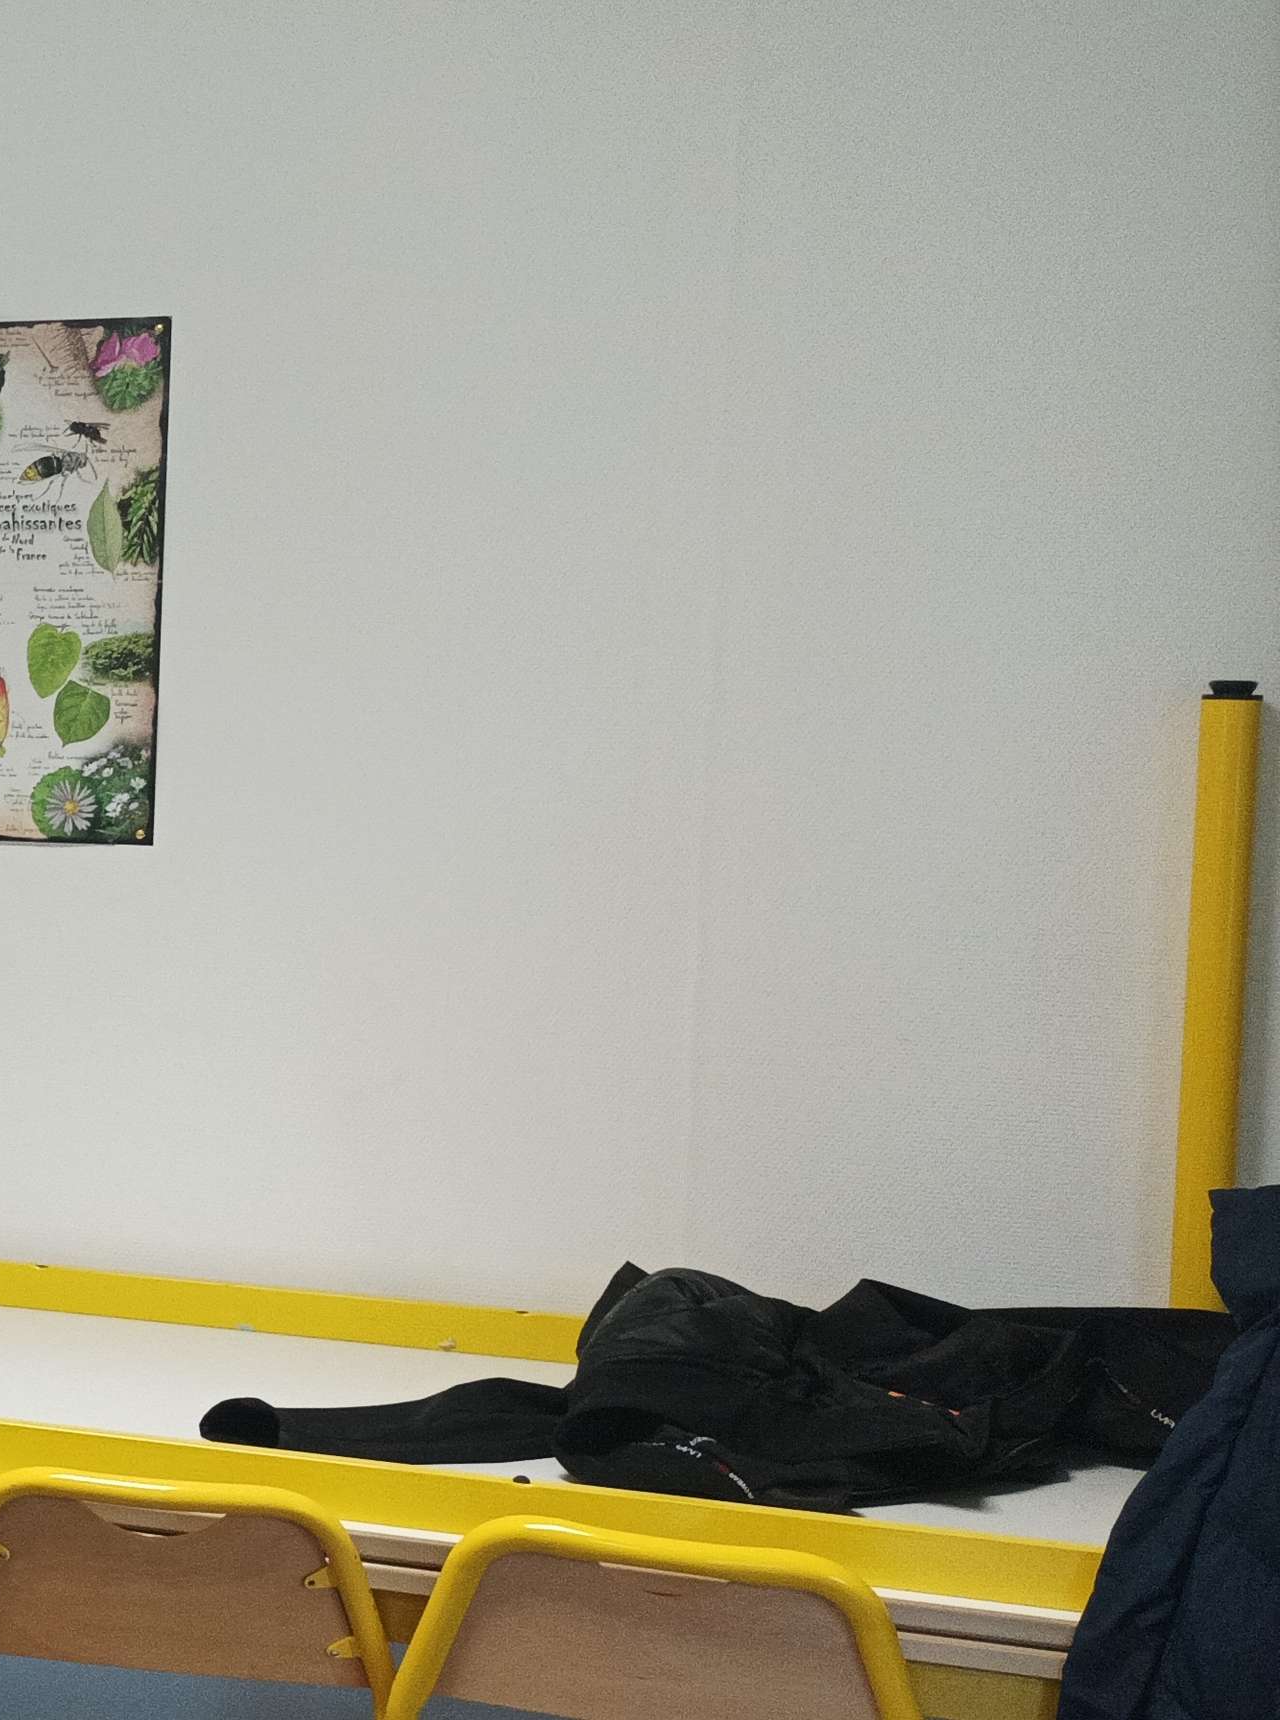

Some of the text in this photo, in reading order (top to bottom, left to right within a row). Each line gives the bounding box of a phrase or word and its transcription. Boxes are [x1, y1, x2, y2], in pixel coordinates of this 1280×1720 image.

[22, 501, 77, 517] exotiques
[11, 533, 35, 546] Nord
[16, 547, 48, 561] France
